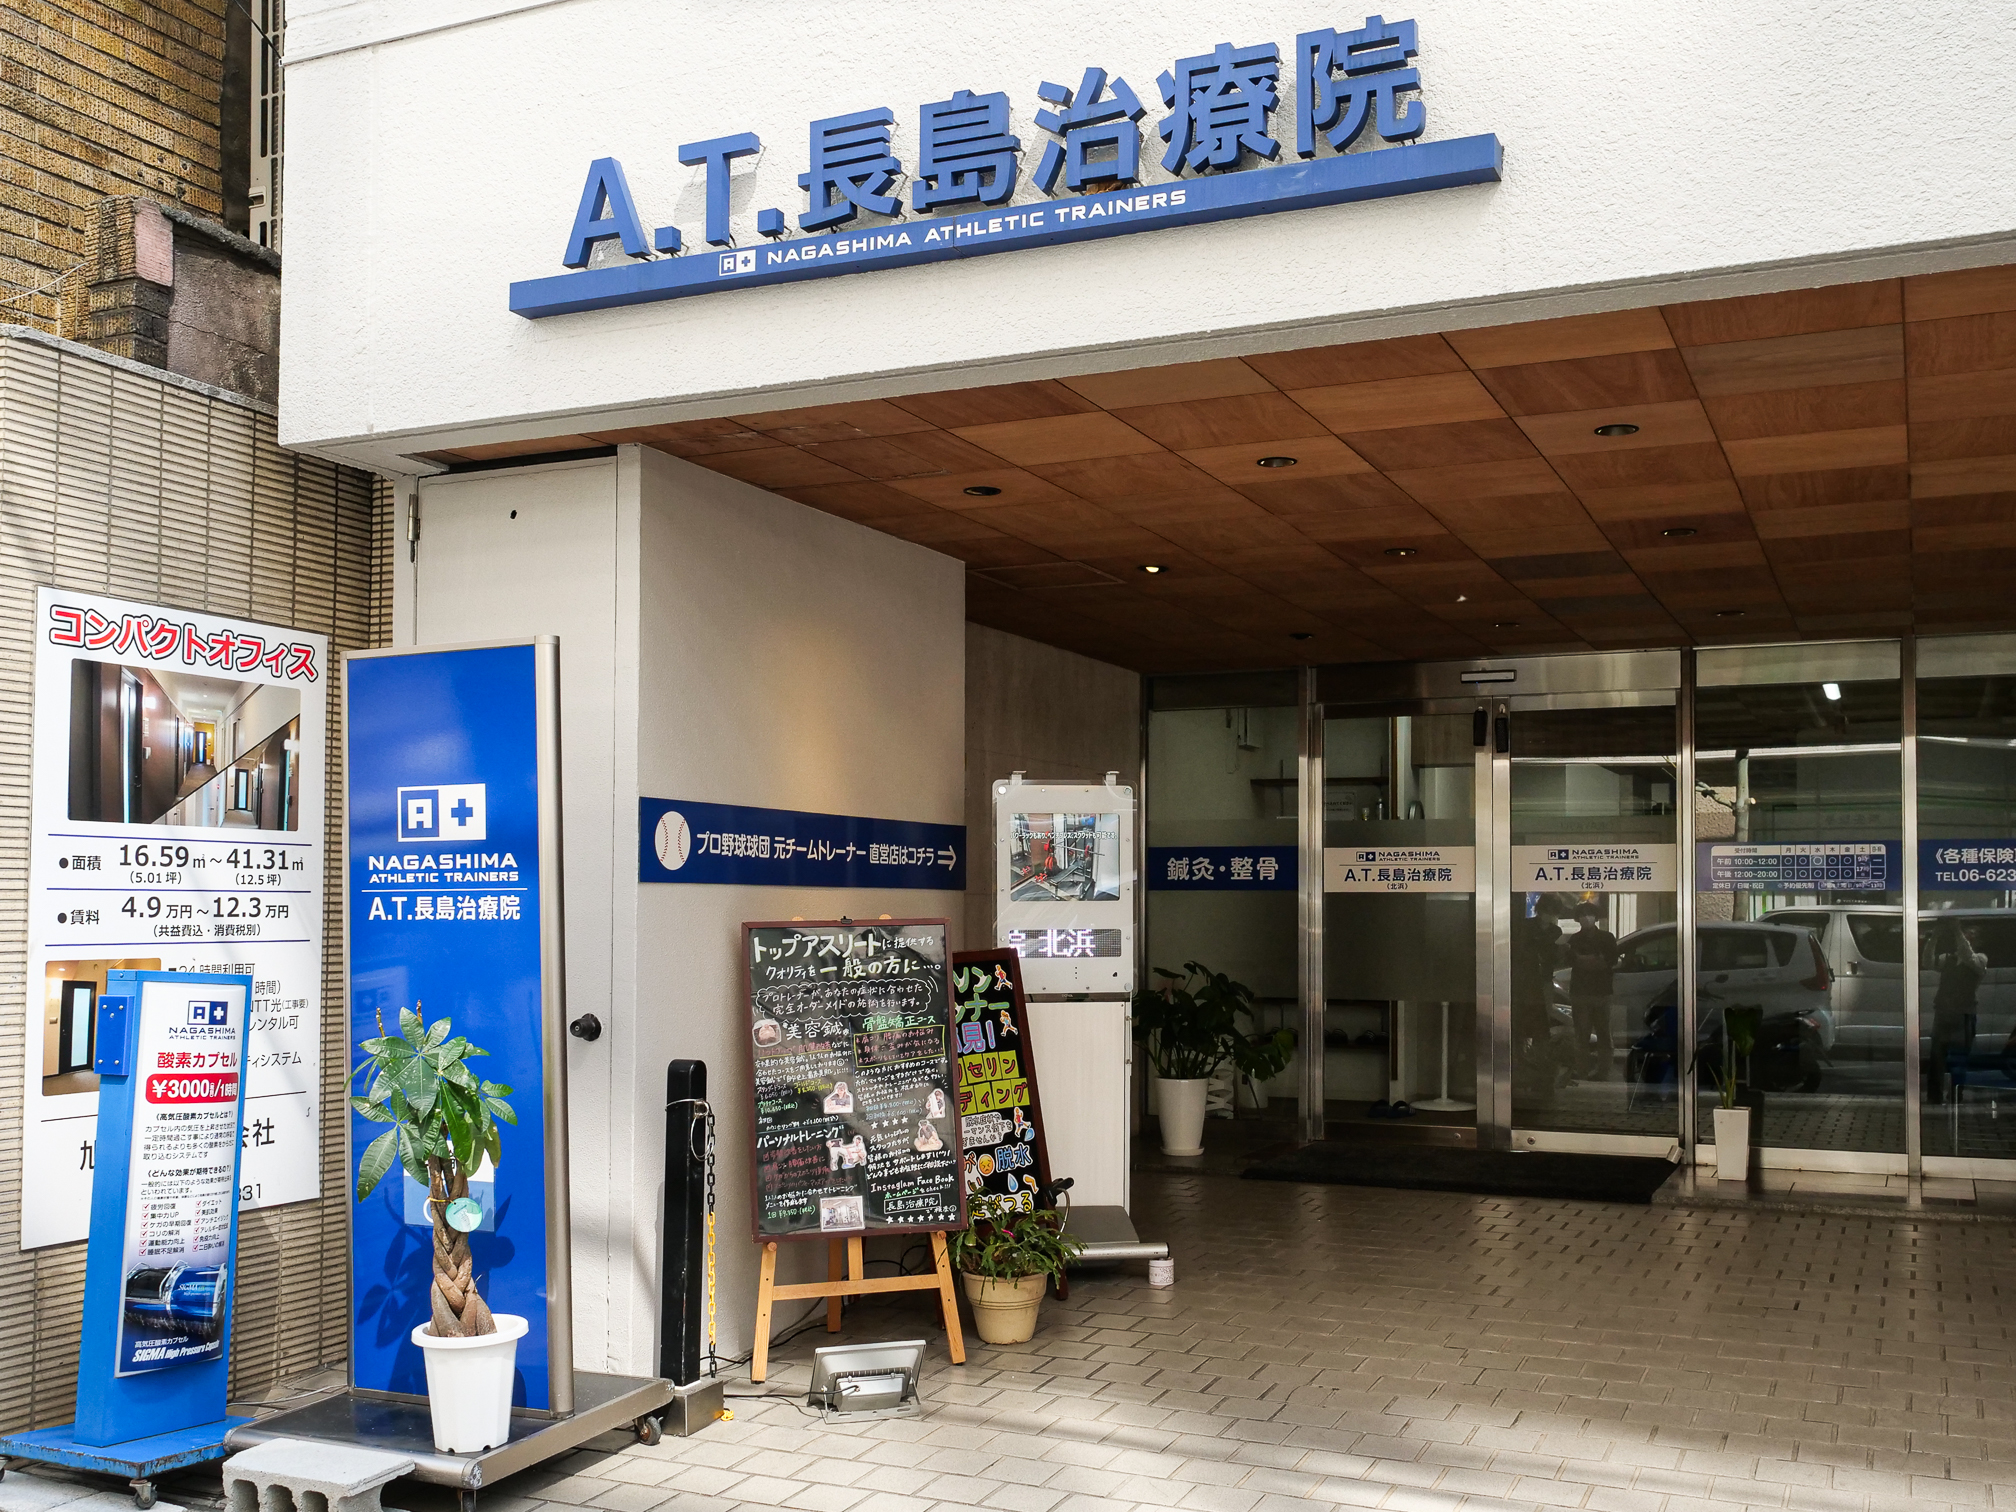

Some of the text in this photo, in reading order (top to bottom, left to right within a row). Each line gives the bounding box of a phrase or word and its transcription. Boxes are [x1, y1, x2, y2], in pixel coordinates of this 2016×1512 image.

[562, 14, 1427, 269] A.T.長島治療院
[767, 232, 912, 265] NAGASHIMA
[924, 211, 1044, 243] ATHLETIC
[1055, 189, 1186, 223] TRAINERS
[50, 604, 318, 682] コンパクトオフィス
[697, 830, 935, 866] プロ野球球団 元チームトレーナー 直営店はコチラ
[1935, 848, 2016, 864] 《各種保険
[71, 855, 101, 871] 面積
[368, 853, 518, 870] NAGASHIMA
[1167, 856, 1279, 881] 鍼灸・整骨
[369, 871, 519, 883] ATHLETIC TRAINERS
[1344, 868, 1452, 882] A.T.長島治療院
[1535, 866, 1652, 881] A.T.長島治療院
[368, 895, 521, 920] A.T.長島治療院
[70, 909, 100, 925] 賃料
[1038, 929, 1096, 957] 北浜
[786, 1021, 843, 1040] 美容鍼
[862, 1015, 936, 1031] 骨盤矯正コース
[956, 1020, 996, 1054] 見!
[157, 1052, 237, 1069] 酸素カプセル
[960, 1082, 1027, 1112] ディング
[757, 1125, 844, 1148] パーソナルトレーニング
[996, 1143, 1032, 1172] 脱水
[917, 1176, 933, 1186] Face
[935, 1174, 955, 1184] Book
[886, 1197, 939, 1211] 長島治療院
[132, 1347, 166, 1362] SIGMA
